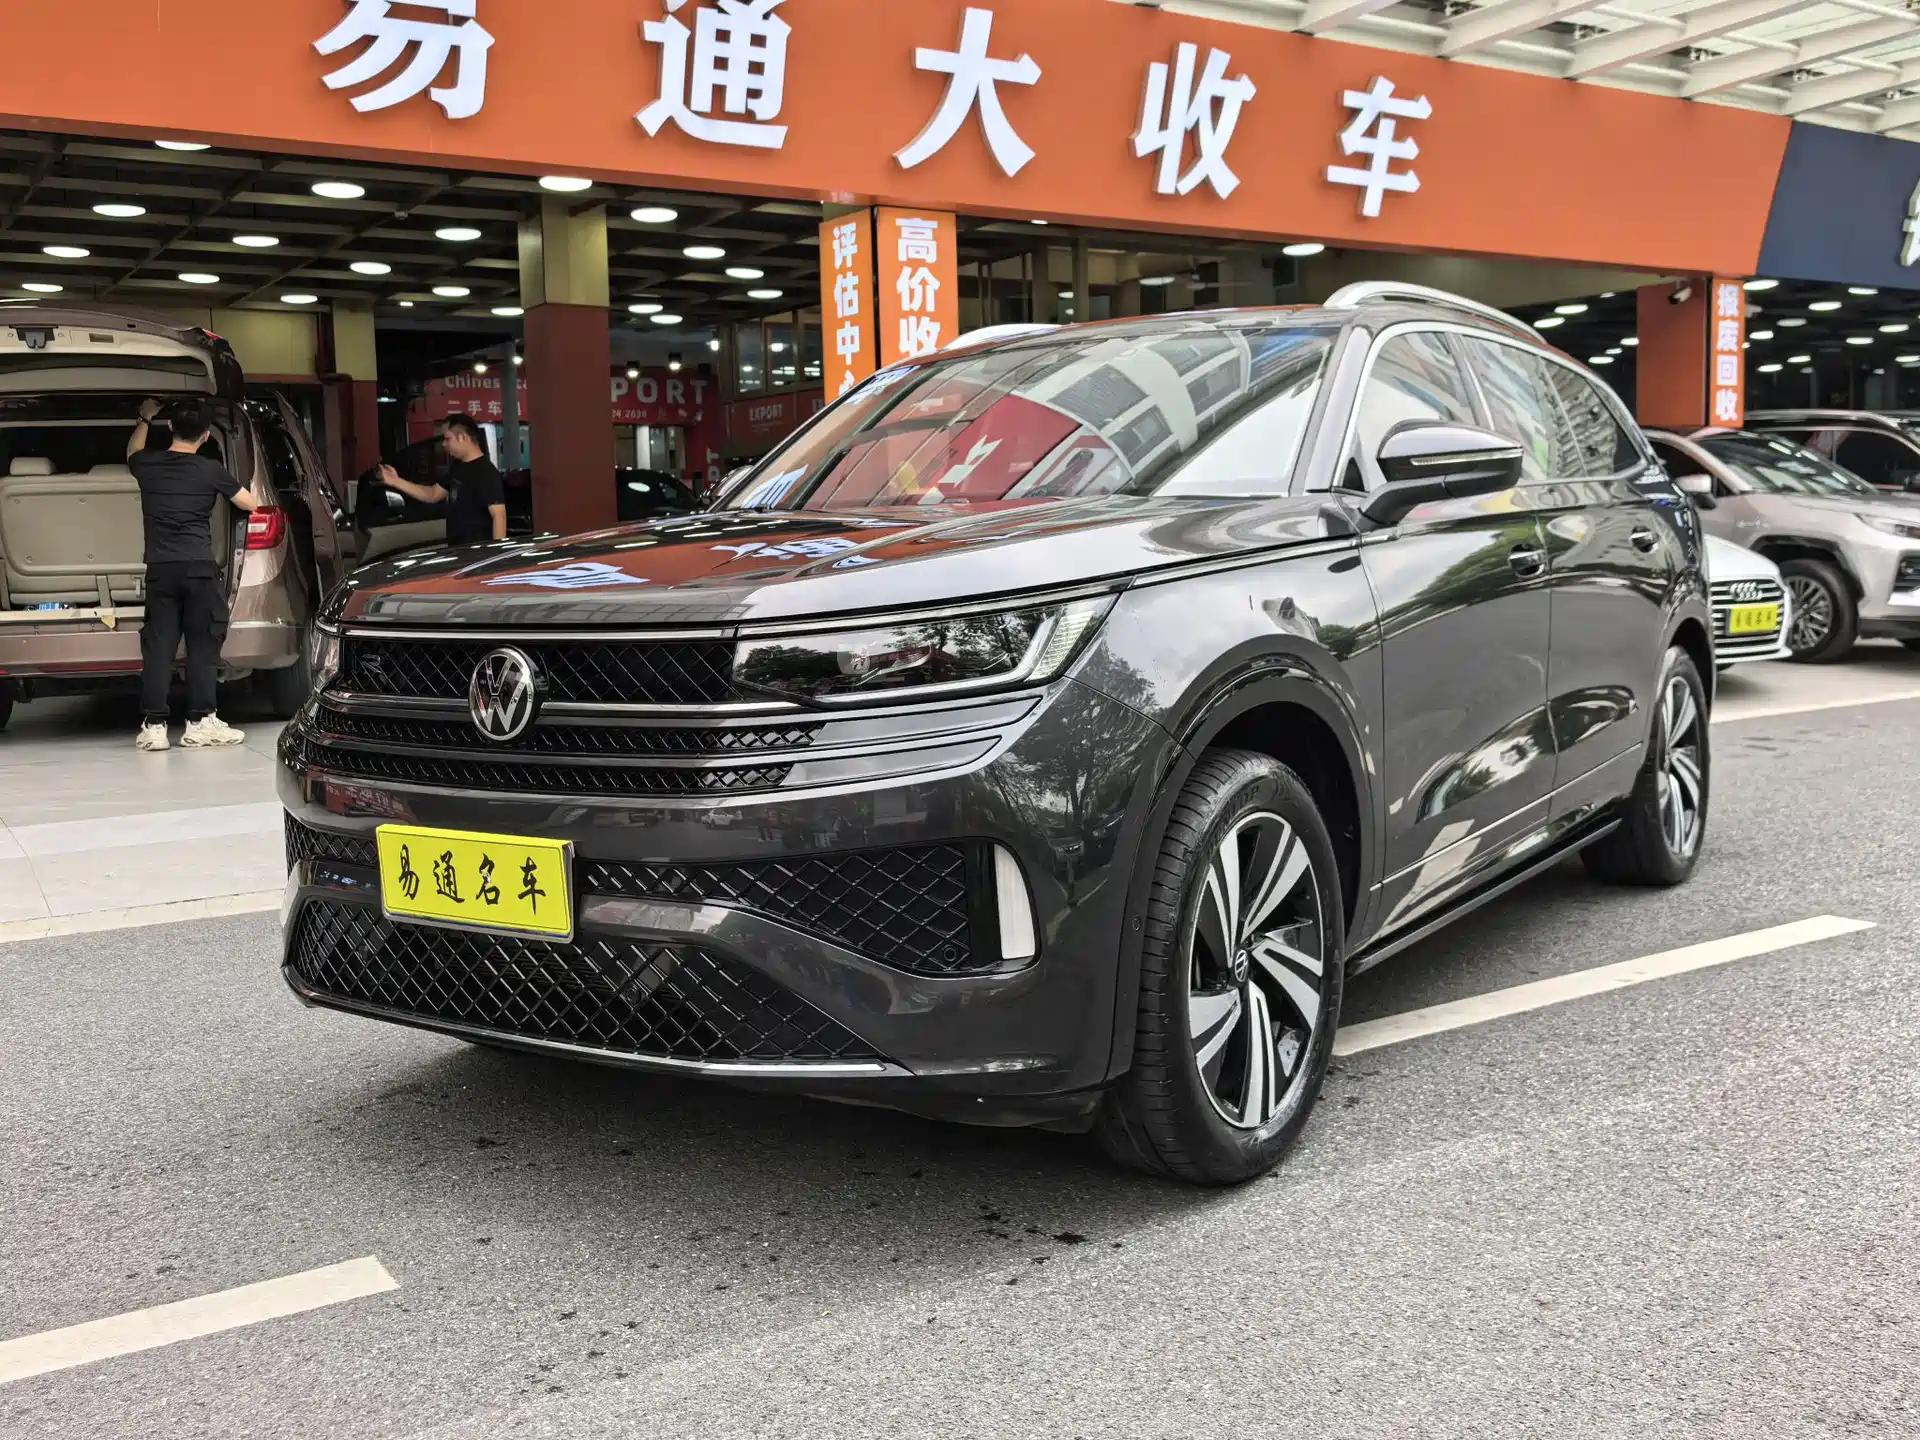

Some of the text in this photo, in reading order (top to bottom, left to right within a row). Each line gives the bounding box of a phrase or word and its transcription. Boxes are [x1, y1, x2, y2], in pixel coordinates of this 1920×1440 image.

[447, 400, 522, 417] 二手车
[398, 843, 546, 915] 易通名车
